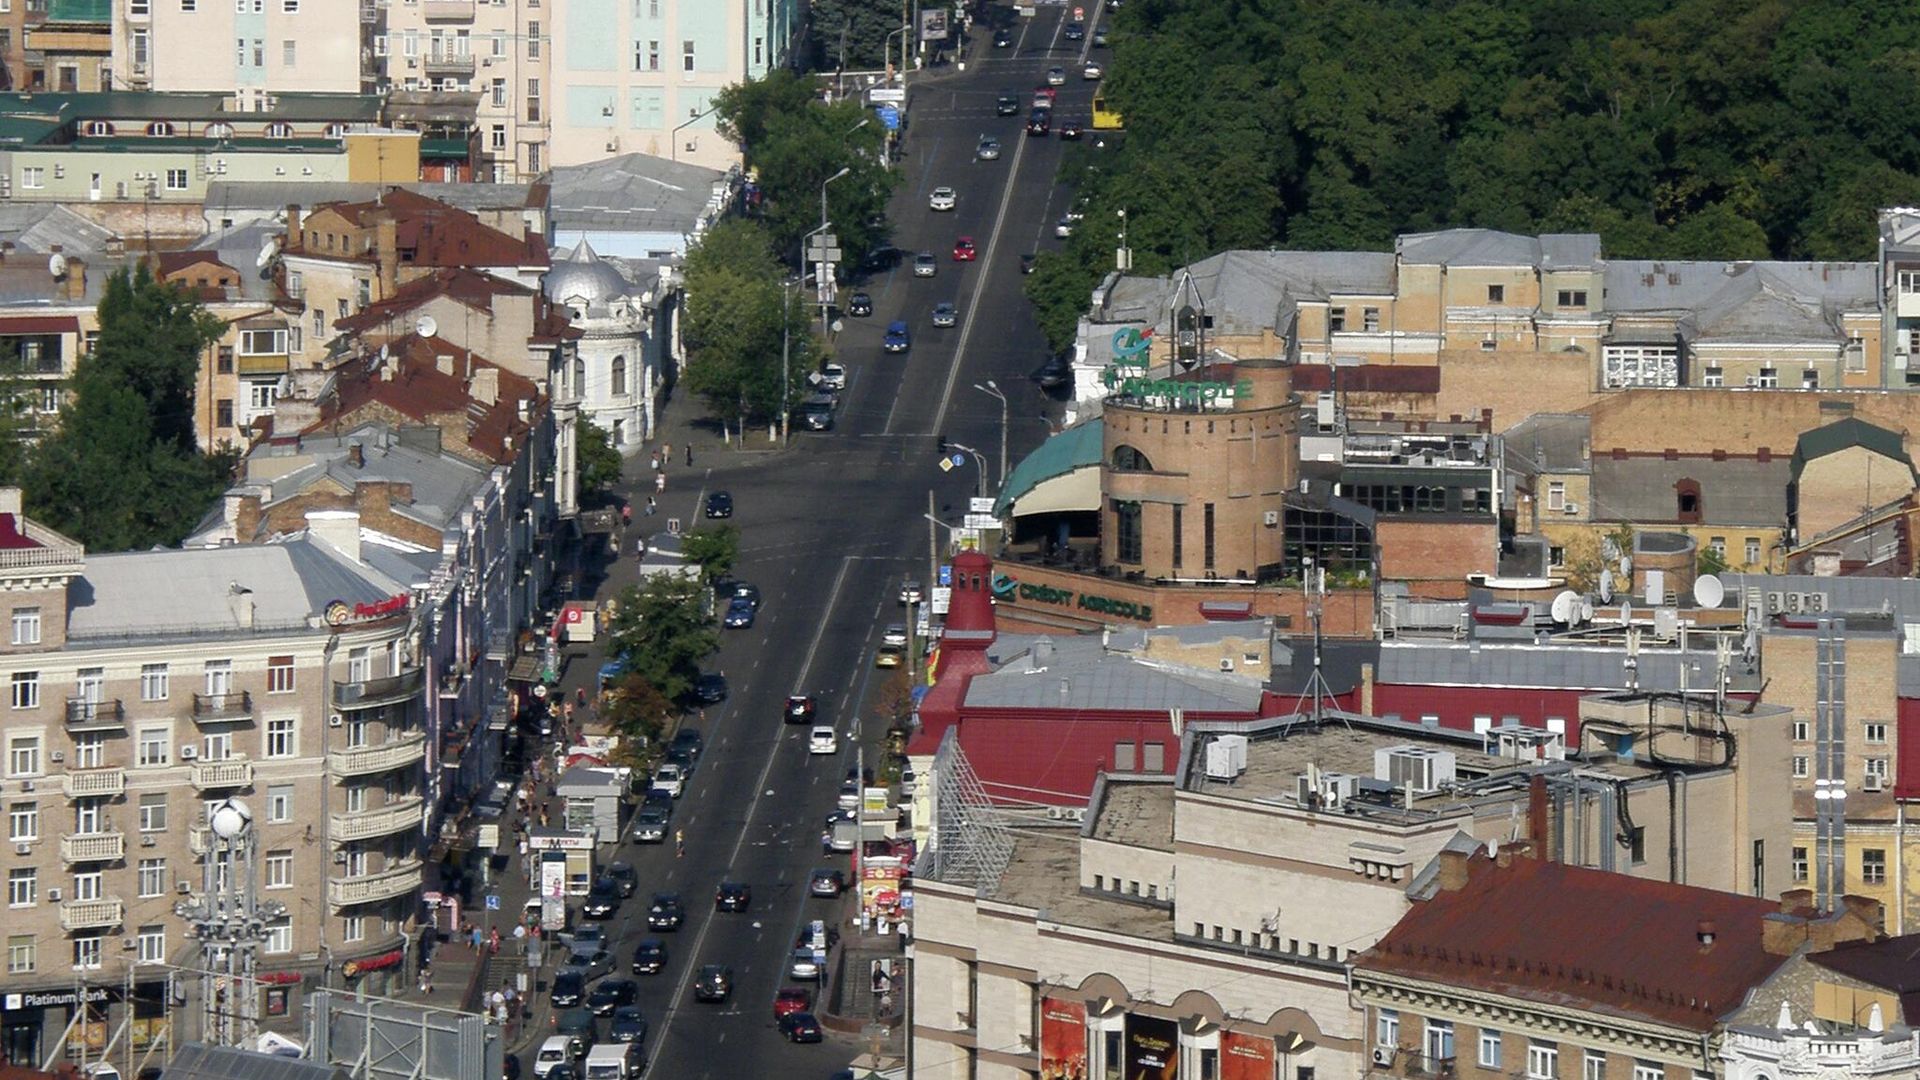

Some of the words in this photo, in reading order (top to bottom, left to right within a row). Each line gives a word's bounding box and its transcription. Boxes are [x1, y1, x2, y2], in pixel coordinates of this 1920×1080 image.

[1121, 377, 1254, 401] AGRICOLE
[1020, 583, 1074, 607] CRÉDIT
[1077, 592, 1153, 622] AGRICOLE
[25, 993, 76, 1006] Platinum
